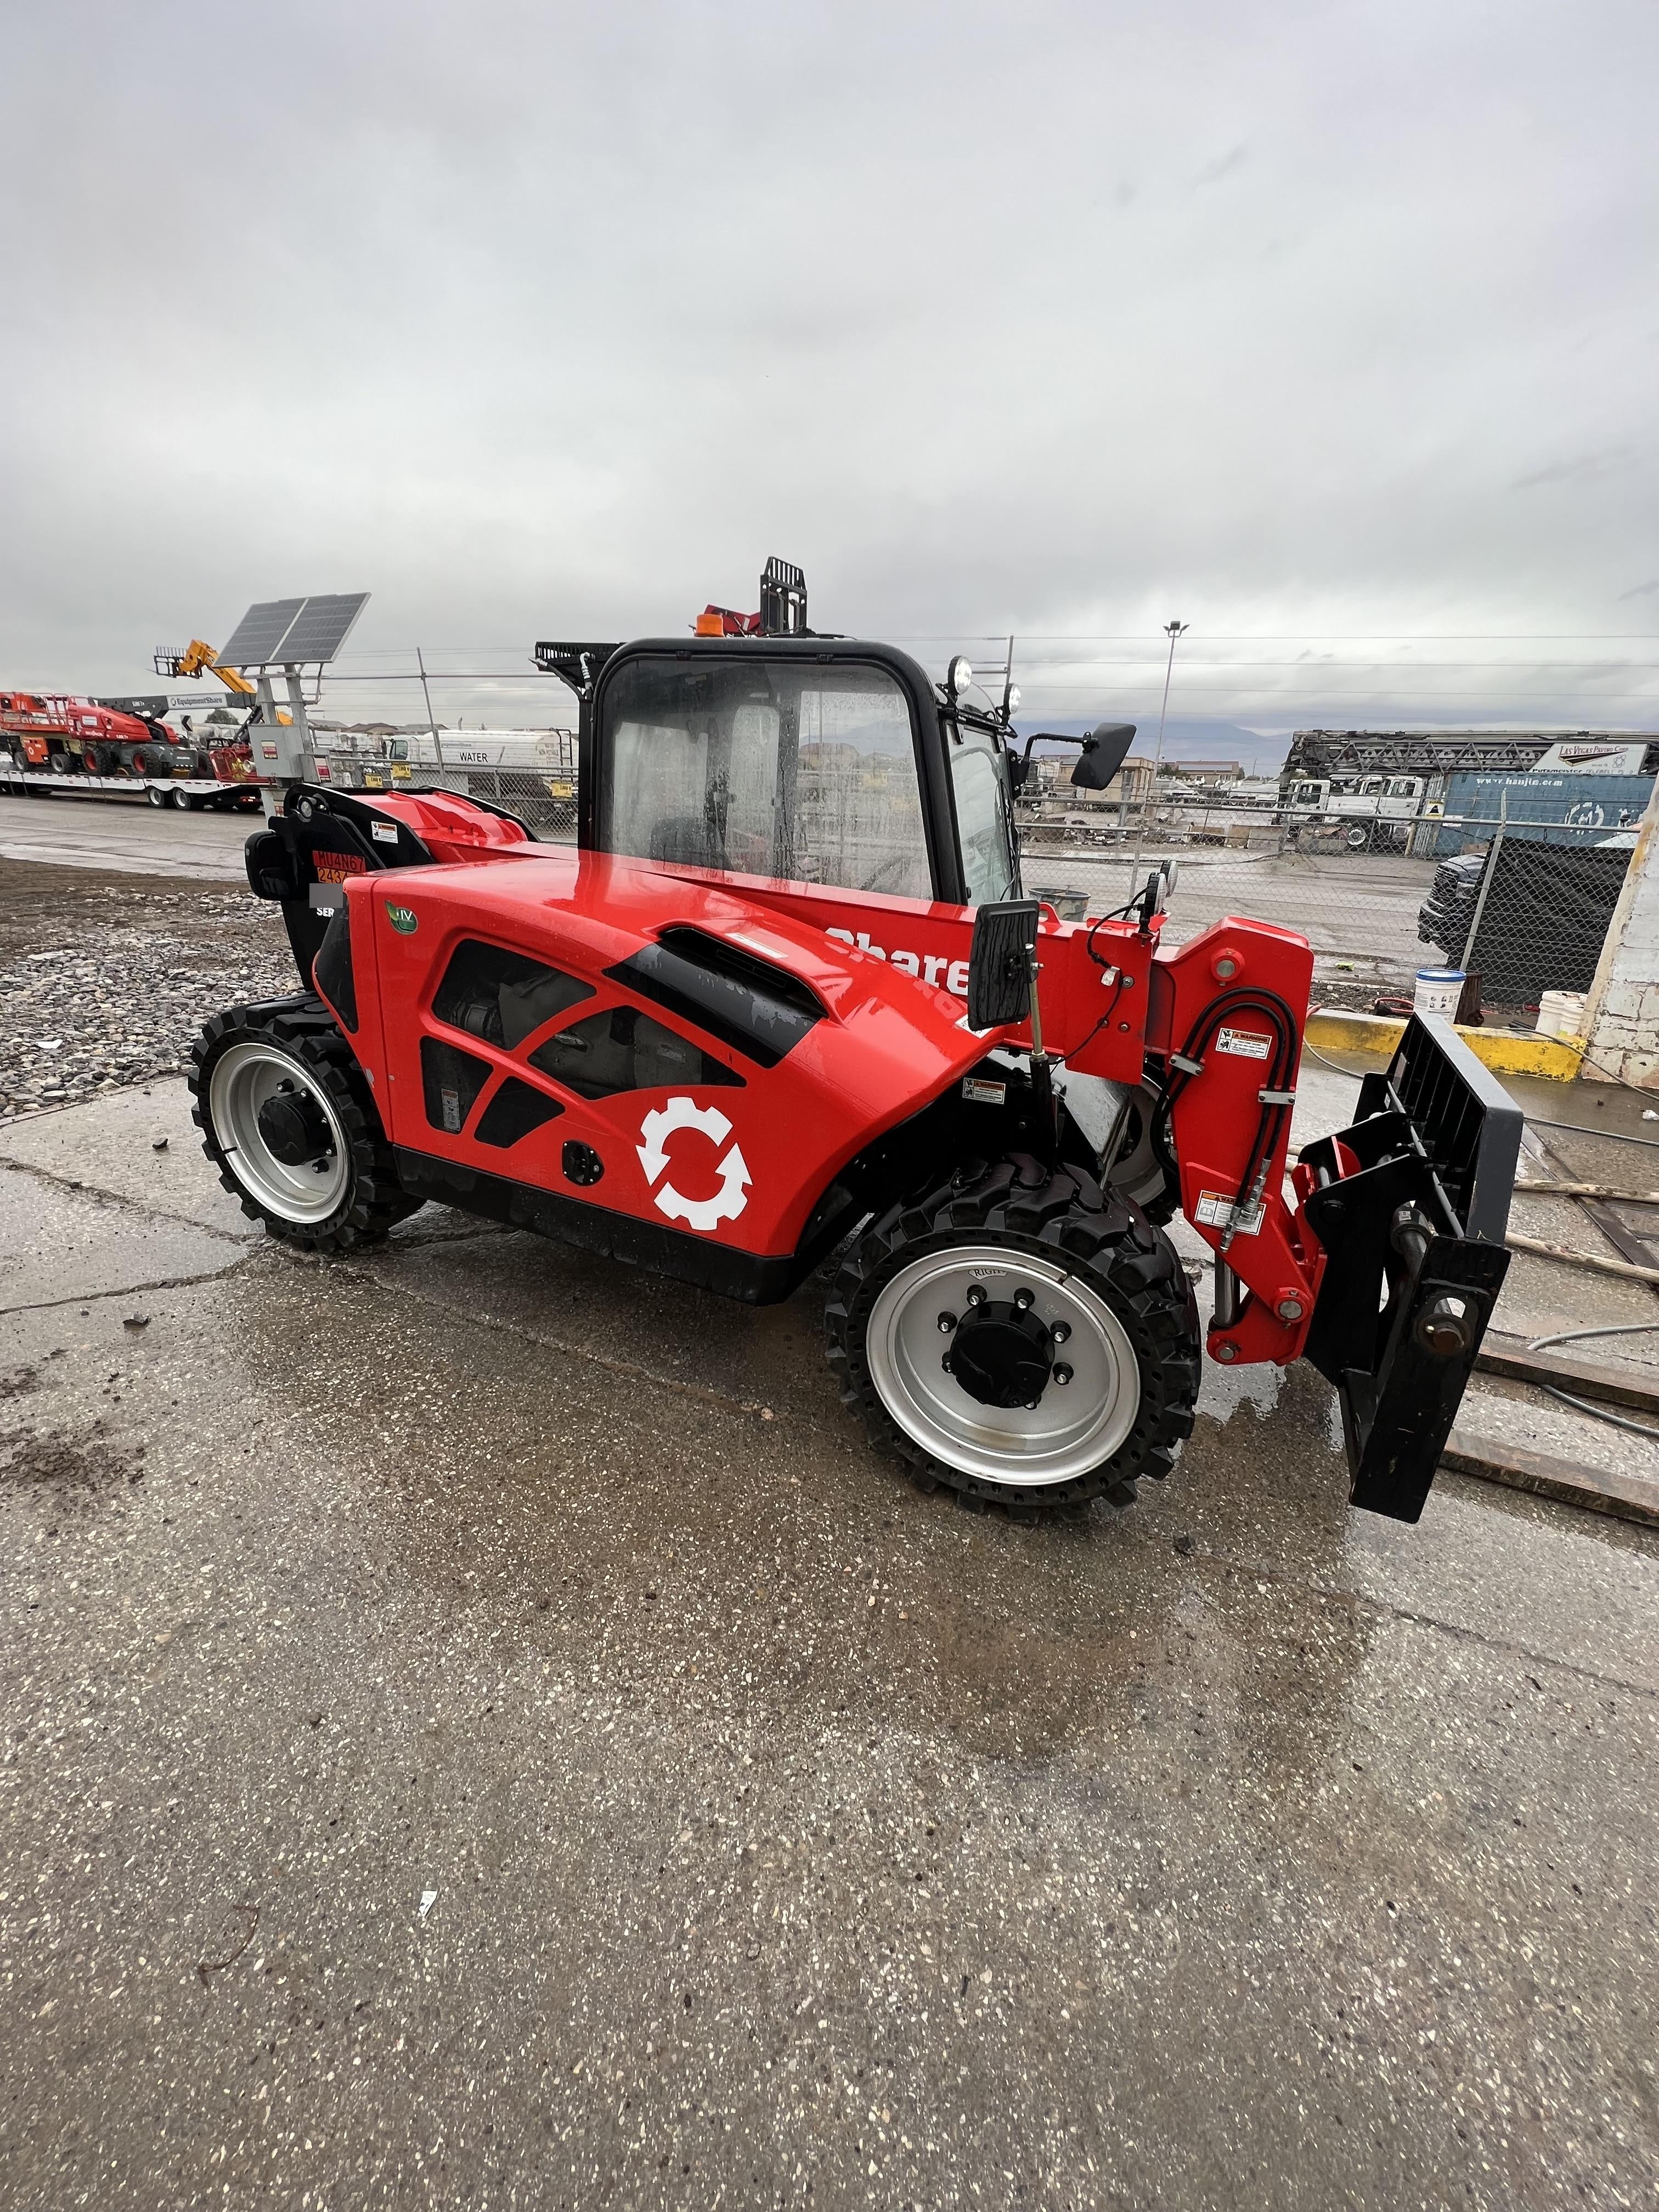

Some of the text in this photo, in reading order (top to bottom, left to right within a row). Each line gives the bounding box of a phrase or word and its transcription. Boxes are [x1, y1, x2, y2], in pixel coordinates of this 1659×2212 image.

[1560, 746, 1572, 755] LAS
[1573, 746, 1592, 754] VEGAS
[460, 752, 488, 763] WATER
[1240, 1034, 1267, 1042] WARNING
